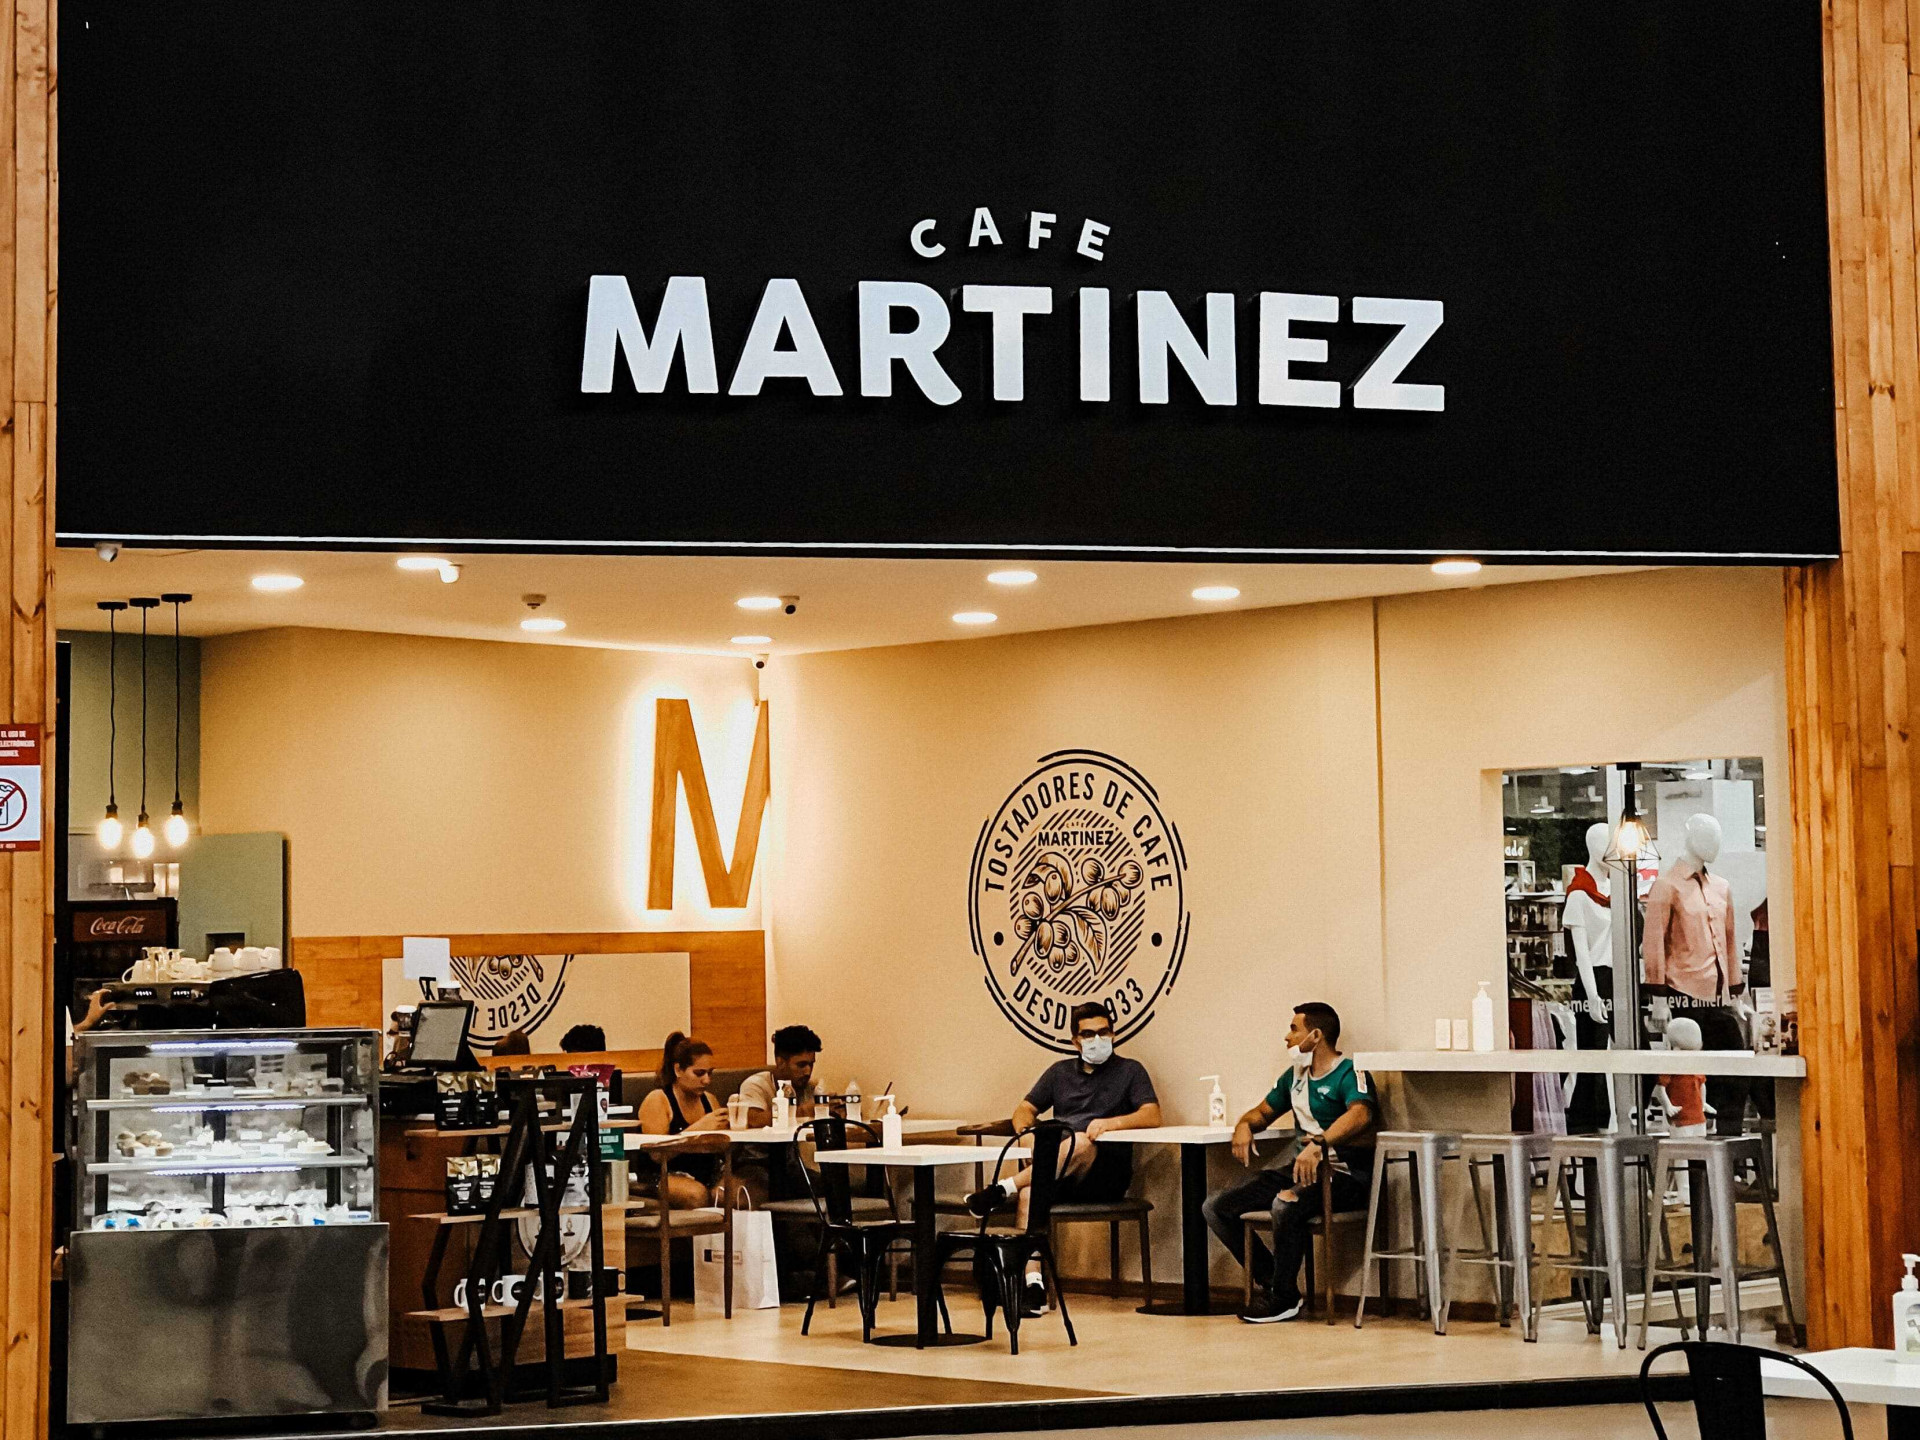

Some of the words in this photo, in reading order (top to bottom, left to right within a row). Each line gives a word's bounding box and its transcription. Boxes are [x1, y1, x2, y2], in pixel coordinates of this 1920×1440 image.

[910, 206, 1111, 261] CAFE
[581, 274, 1445, 411] MARTINEZ
[985, 772, 1095, 892] TOSTADORES
[1103, 780, 1134, 820] DE
[1132, 814, 1173, 891] CAFE
[1037, 830, 1114, 847] MARTINEZ
[1013, 976, 1076, 1031] DESD
[1103, 978, 1144, 1024] 933
